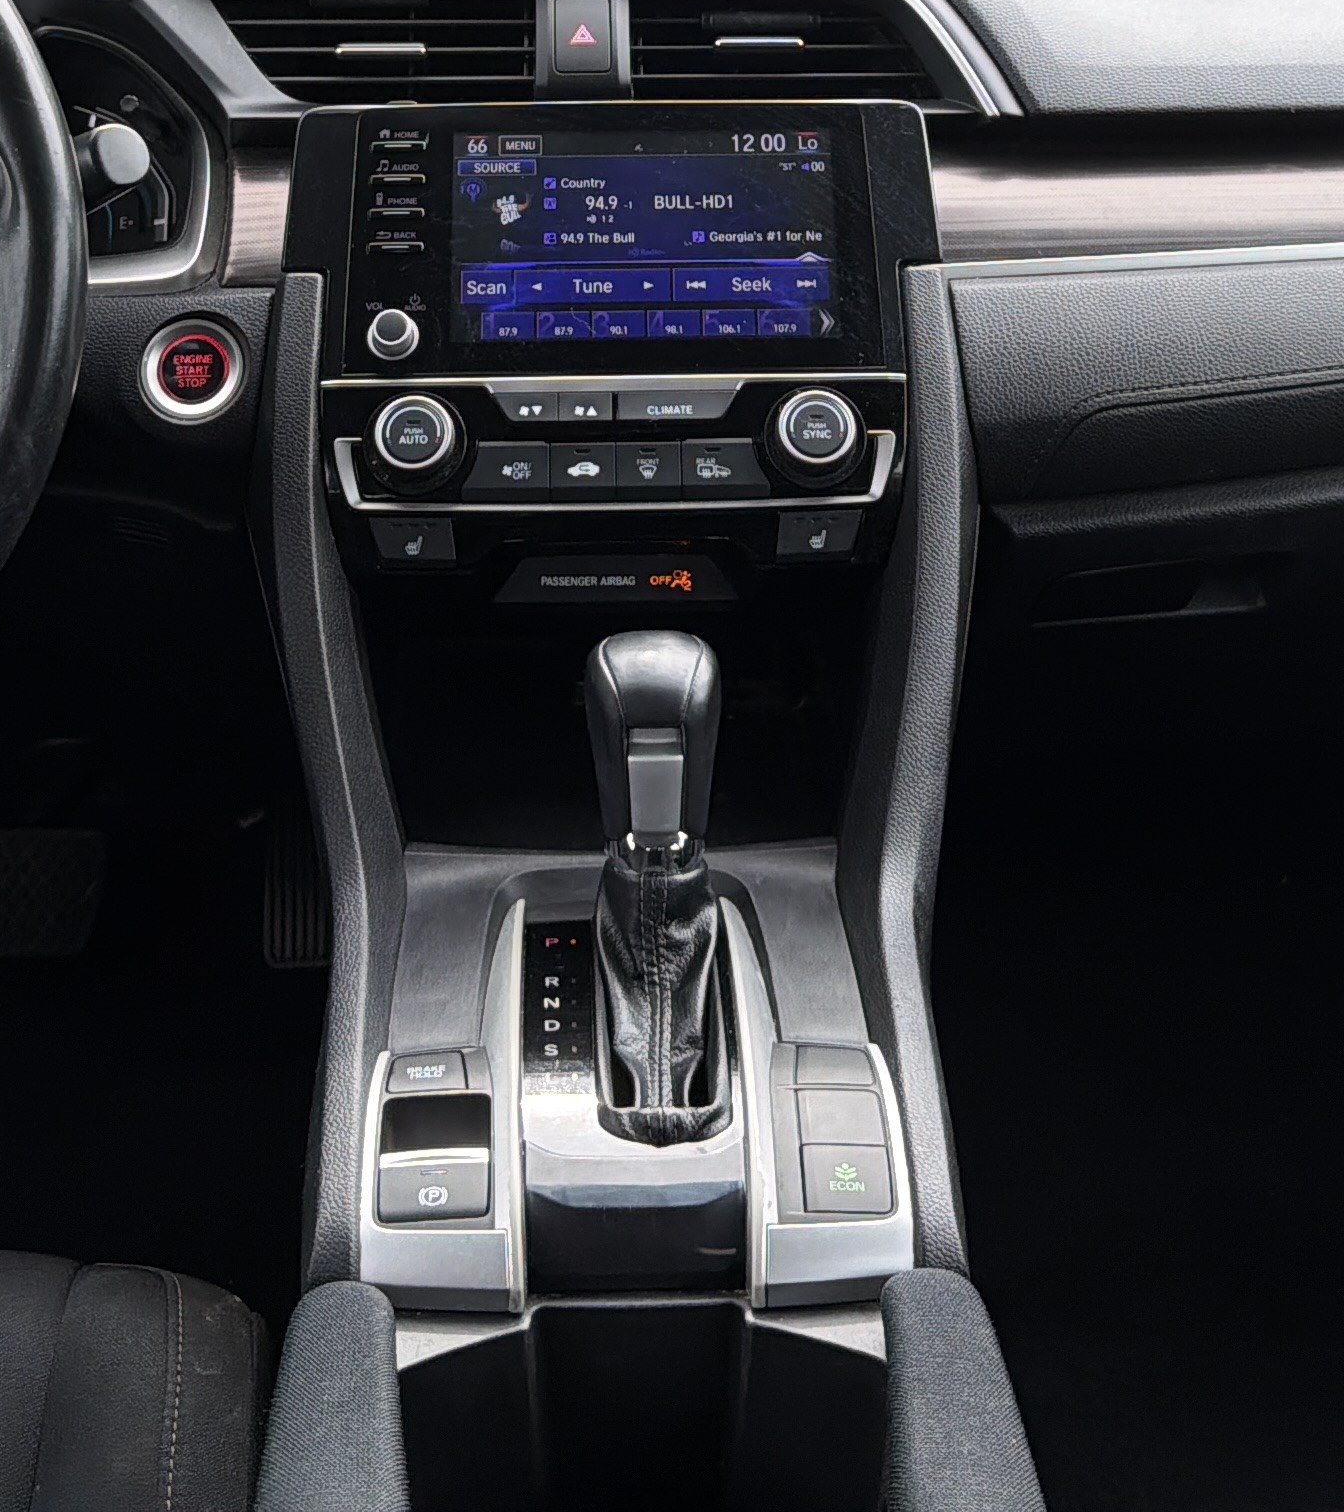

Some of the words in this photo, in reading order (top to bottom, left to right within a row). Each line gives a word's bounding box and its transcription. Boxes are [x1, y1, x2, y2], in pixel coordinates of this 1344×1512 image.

[394, 131, 419, 139] HOME
[467, 138, 488, 154] 66
[505, 140, 536, 151] MENU
[797, 135, 818, 150] Lo
[392, 162, 419, 171] AUDIO
[473, 161, 521, 174] SOURCE
[811, 161, 825, 173] 00
[560, 177, 607, 190] Country
[387, 197, 418, 206] PHONE
[585, 195, 618, 210] 94.9
[654, 194, 733, 210] BULL-HD1
[119, 216, 128, 229] E
[393, 231, 417, 239] BACK
[560, 233, 584, 244] 94.9
[587, 232, 609, 243] The
[613, 232, 635, 243] Bull
[709, 230, 763, 243] Georgia's
[766, 230, 782, 242] #1
[786, 230, 803, 242] for
[806, 230, 823, 242] Ne
[466, 280, 507, 295] Scan
[572, 279, 614, 294] Tune
[731, 276, 772, 292] Seek
[499, 327, 518, 337] 87.9
[554, 326, 573, 336] 87.9
[609, 325, 628, 335] 90.1
[664, 324, 683, 334] 98.1
[718, 323, 741, 333] 106.1
[773, 323, 797, 333] 107.9
[173, 354, 213, 365] ENGINE
[176, 365, 209, 375] START
[178, 378, 207, 388] STOP
[646, 404, 693, 415] CLIMATE
[807, 421, 827, 429] PUSH
[404, 427, 423, 435] PUSH
[802, 428, 832, 440] SYNC
[398, 434, 429, 445] AUTO
[512, 461, 532, 471] ON/
[695, 457, 715, 465] REAR
[512, 470, 532, 480] OFF
[540, 575, 598, 586] PASSENGER
[600, 575, 636, 586] AIRBAG
[649, 575, 672, 586] OFF
[545, 937, 560, 948] P
[544, 976, 560, 988] R
[543, 996, 560, 1009] N
[544, 1019, 561, 1031] D
[544, 1043, 559, 1056] S
[829, 1180, 865, 1192] ECON
